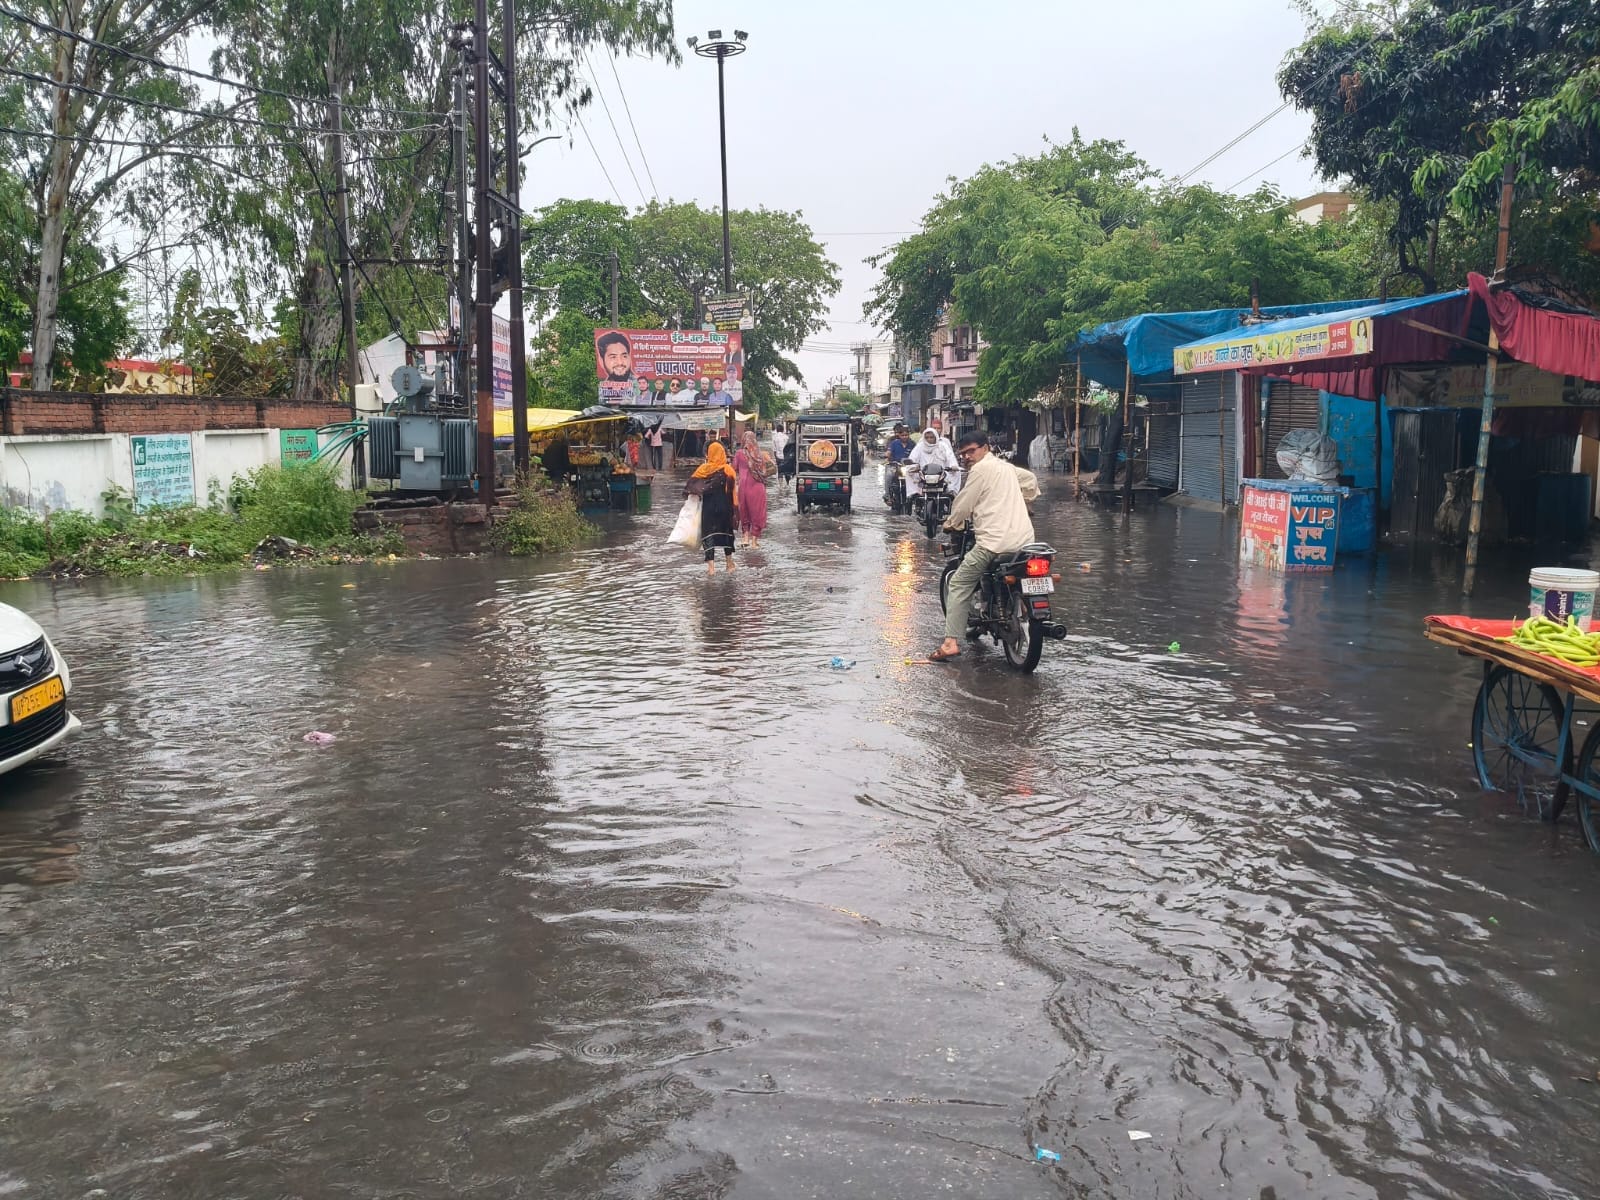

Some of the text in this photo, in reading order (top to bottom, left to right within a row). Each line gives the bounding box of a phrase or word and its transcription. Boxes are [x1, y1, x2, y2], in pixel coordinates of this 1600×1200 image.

[655, 361, 680, 376] प्रधान
[680, 360, 695, 375] पद
[1292, 494, 1335, 504] WELCOME
[1290, 506, 1335, 524] VIP
